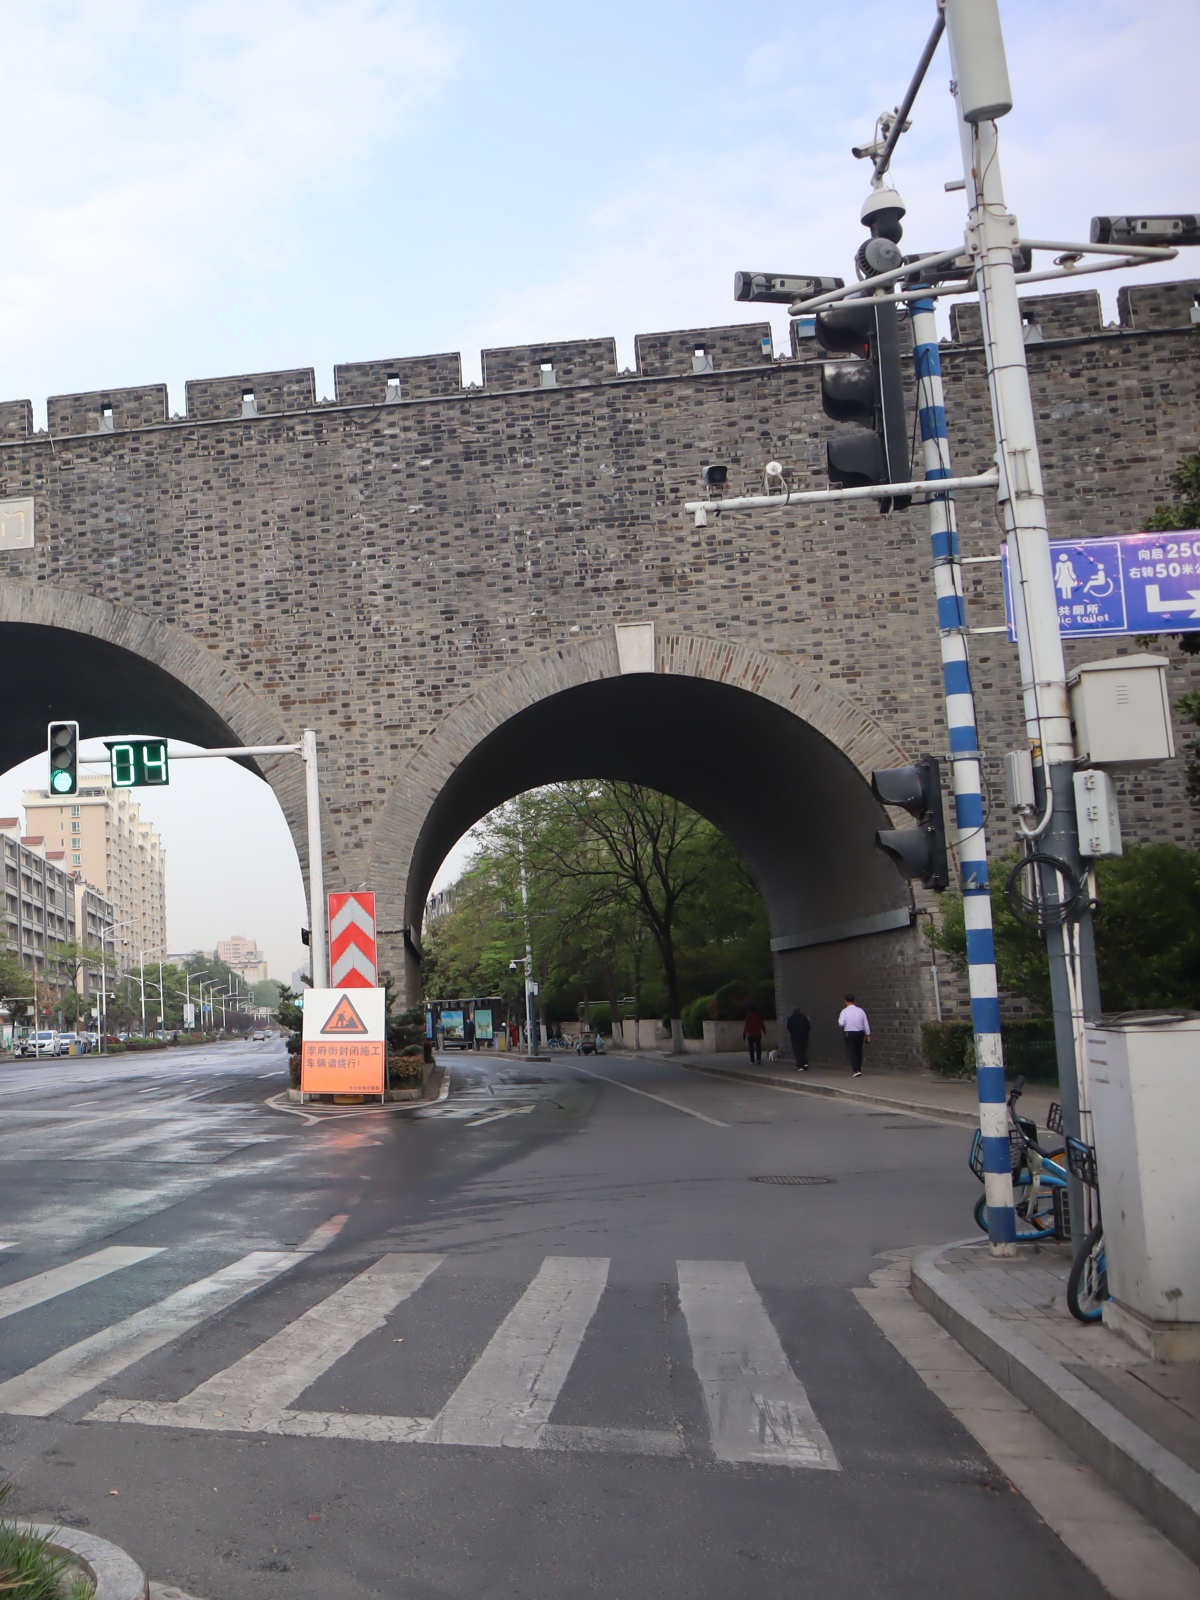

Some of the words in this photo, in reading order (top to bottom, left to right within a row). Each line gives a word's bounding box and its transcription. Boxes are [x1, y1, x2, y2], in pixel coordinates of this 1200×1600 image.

[1077, 613, 1109, 623] toilet
[111, 744, 167, 786] 04
[307, 1045, 381, 1056] 李府街封闭施工
